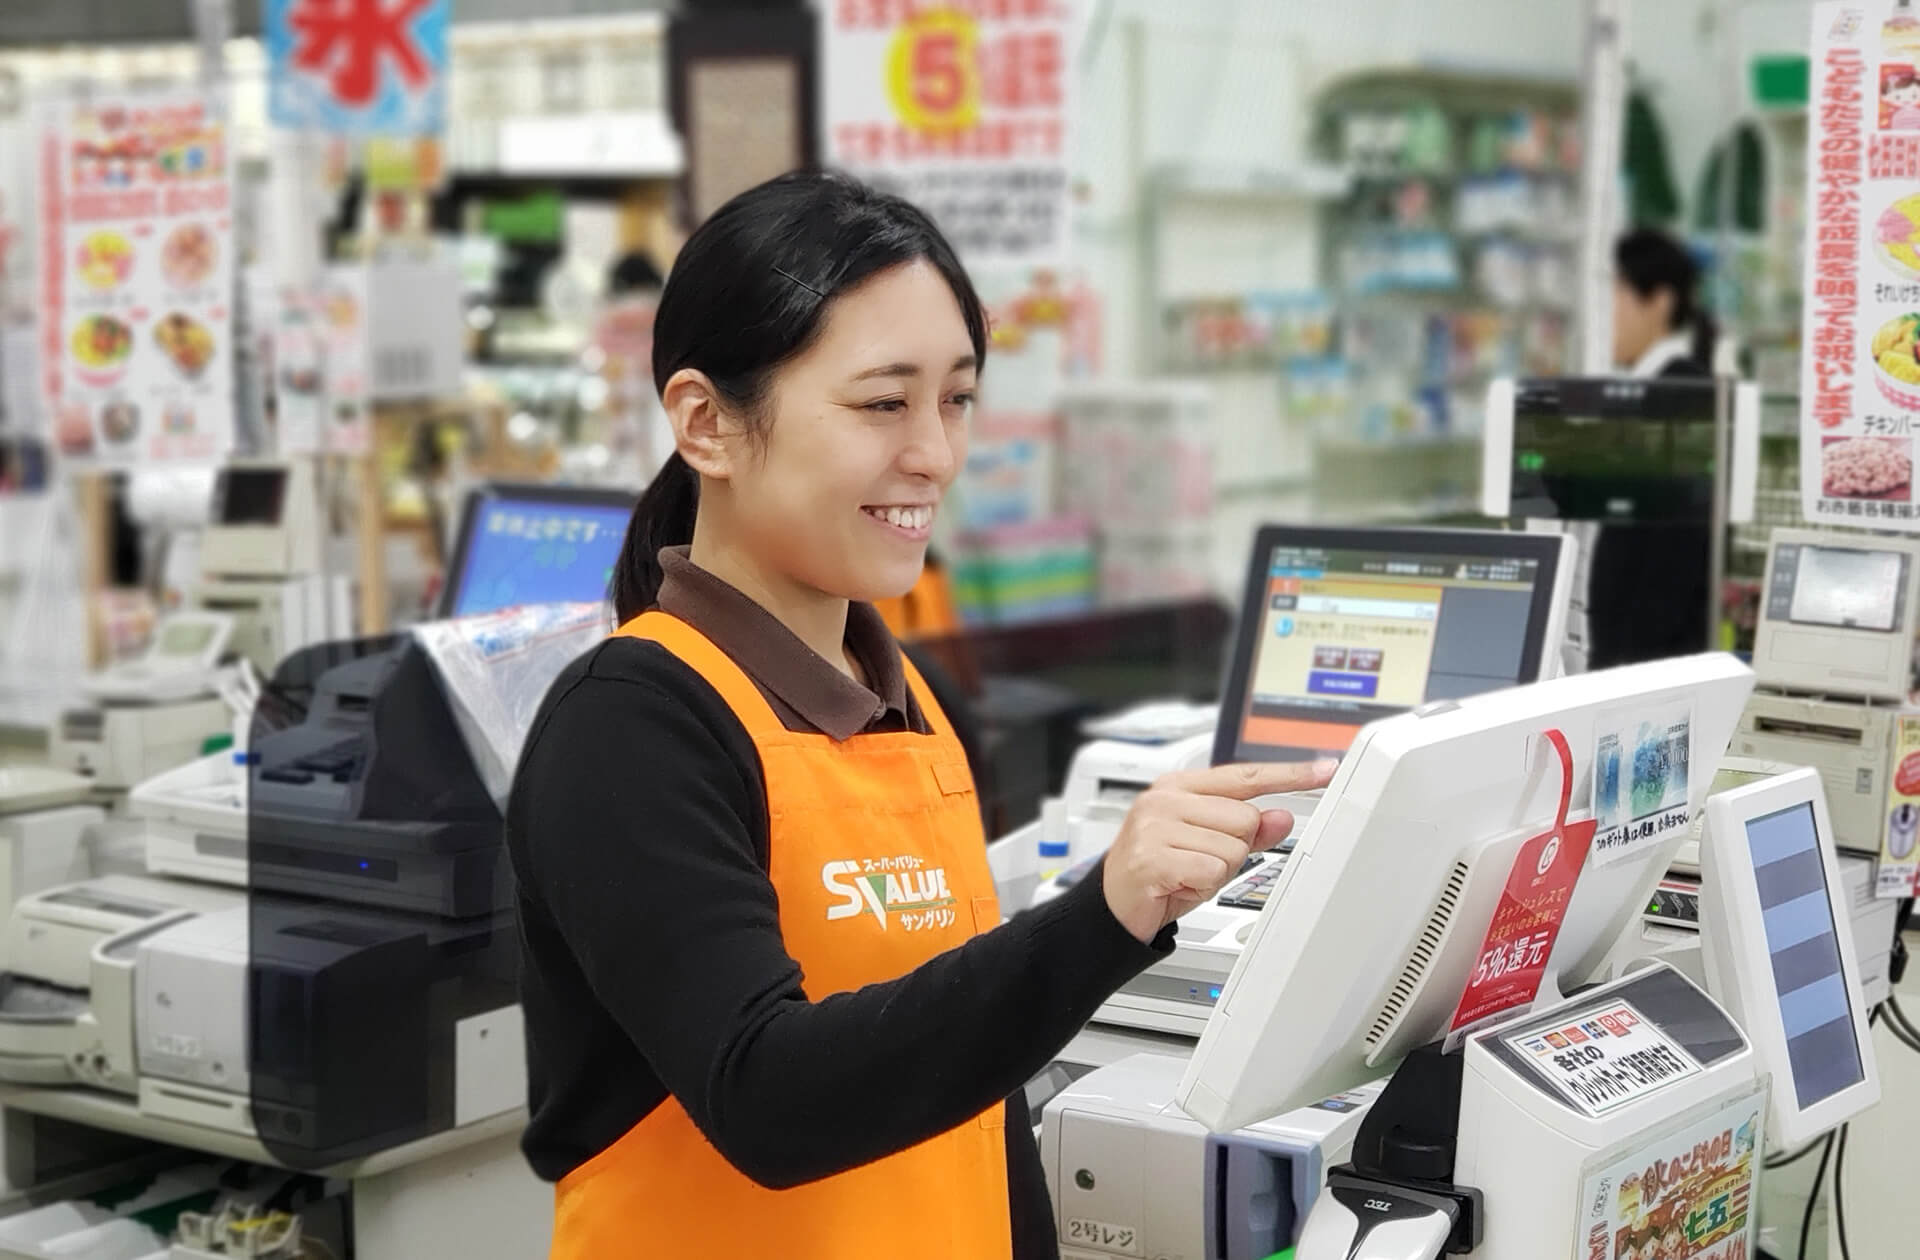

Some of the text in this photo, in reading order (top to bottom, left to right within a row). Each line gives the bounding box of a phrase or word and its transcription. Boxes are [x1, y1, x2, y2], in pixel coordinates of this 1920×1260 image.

[862, 855, 924, 873] スーパーバリュー
[900, 908, 956, 932] サングリン
[1471, 931, 1550, 989] 5%還元
[1552, 1045, 1605, 1073] 各社の
[1364, 1199, 1393, 1212] TEC
[1683, 1183, 1752, 1244] 七五三
[1070, 1221, 1135, 1248] 2号レジ
